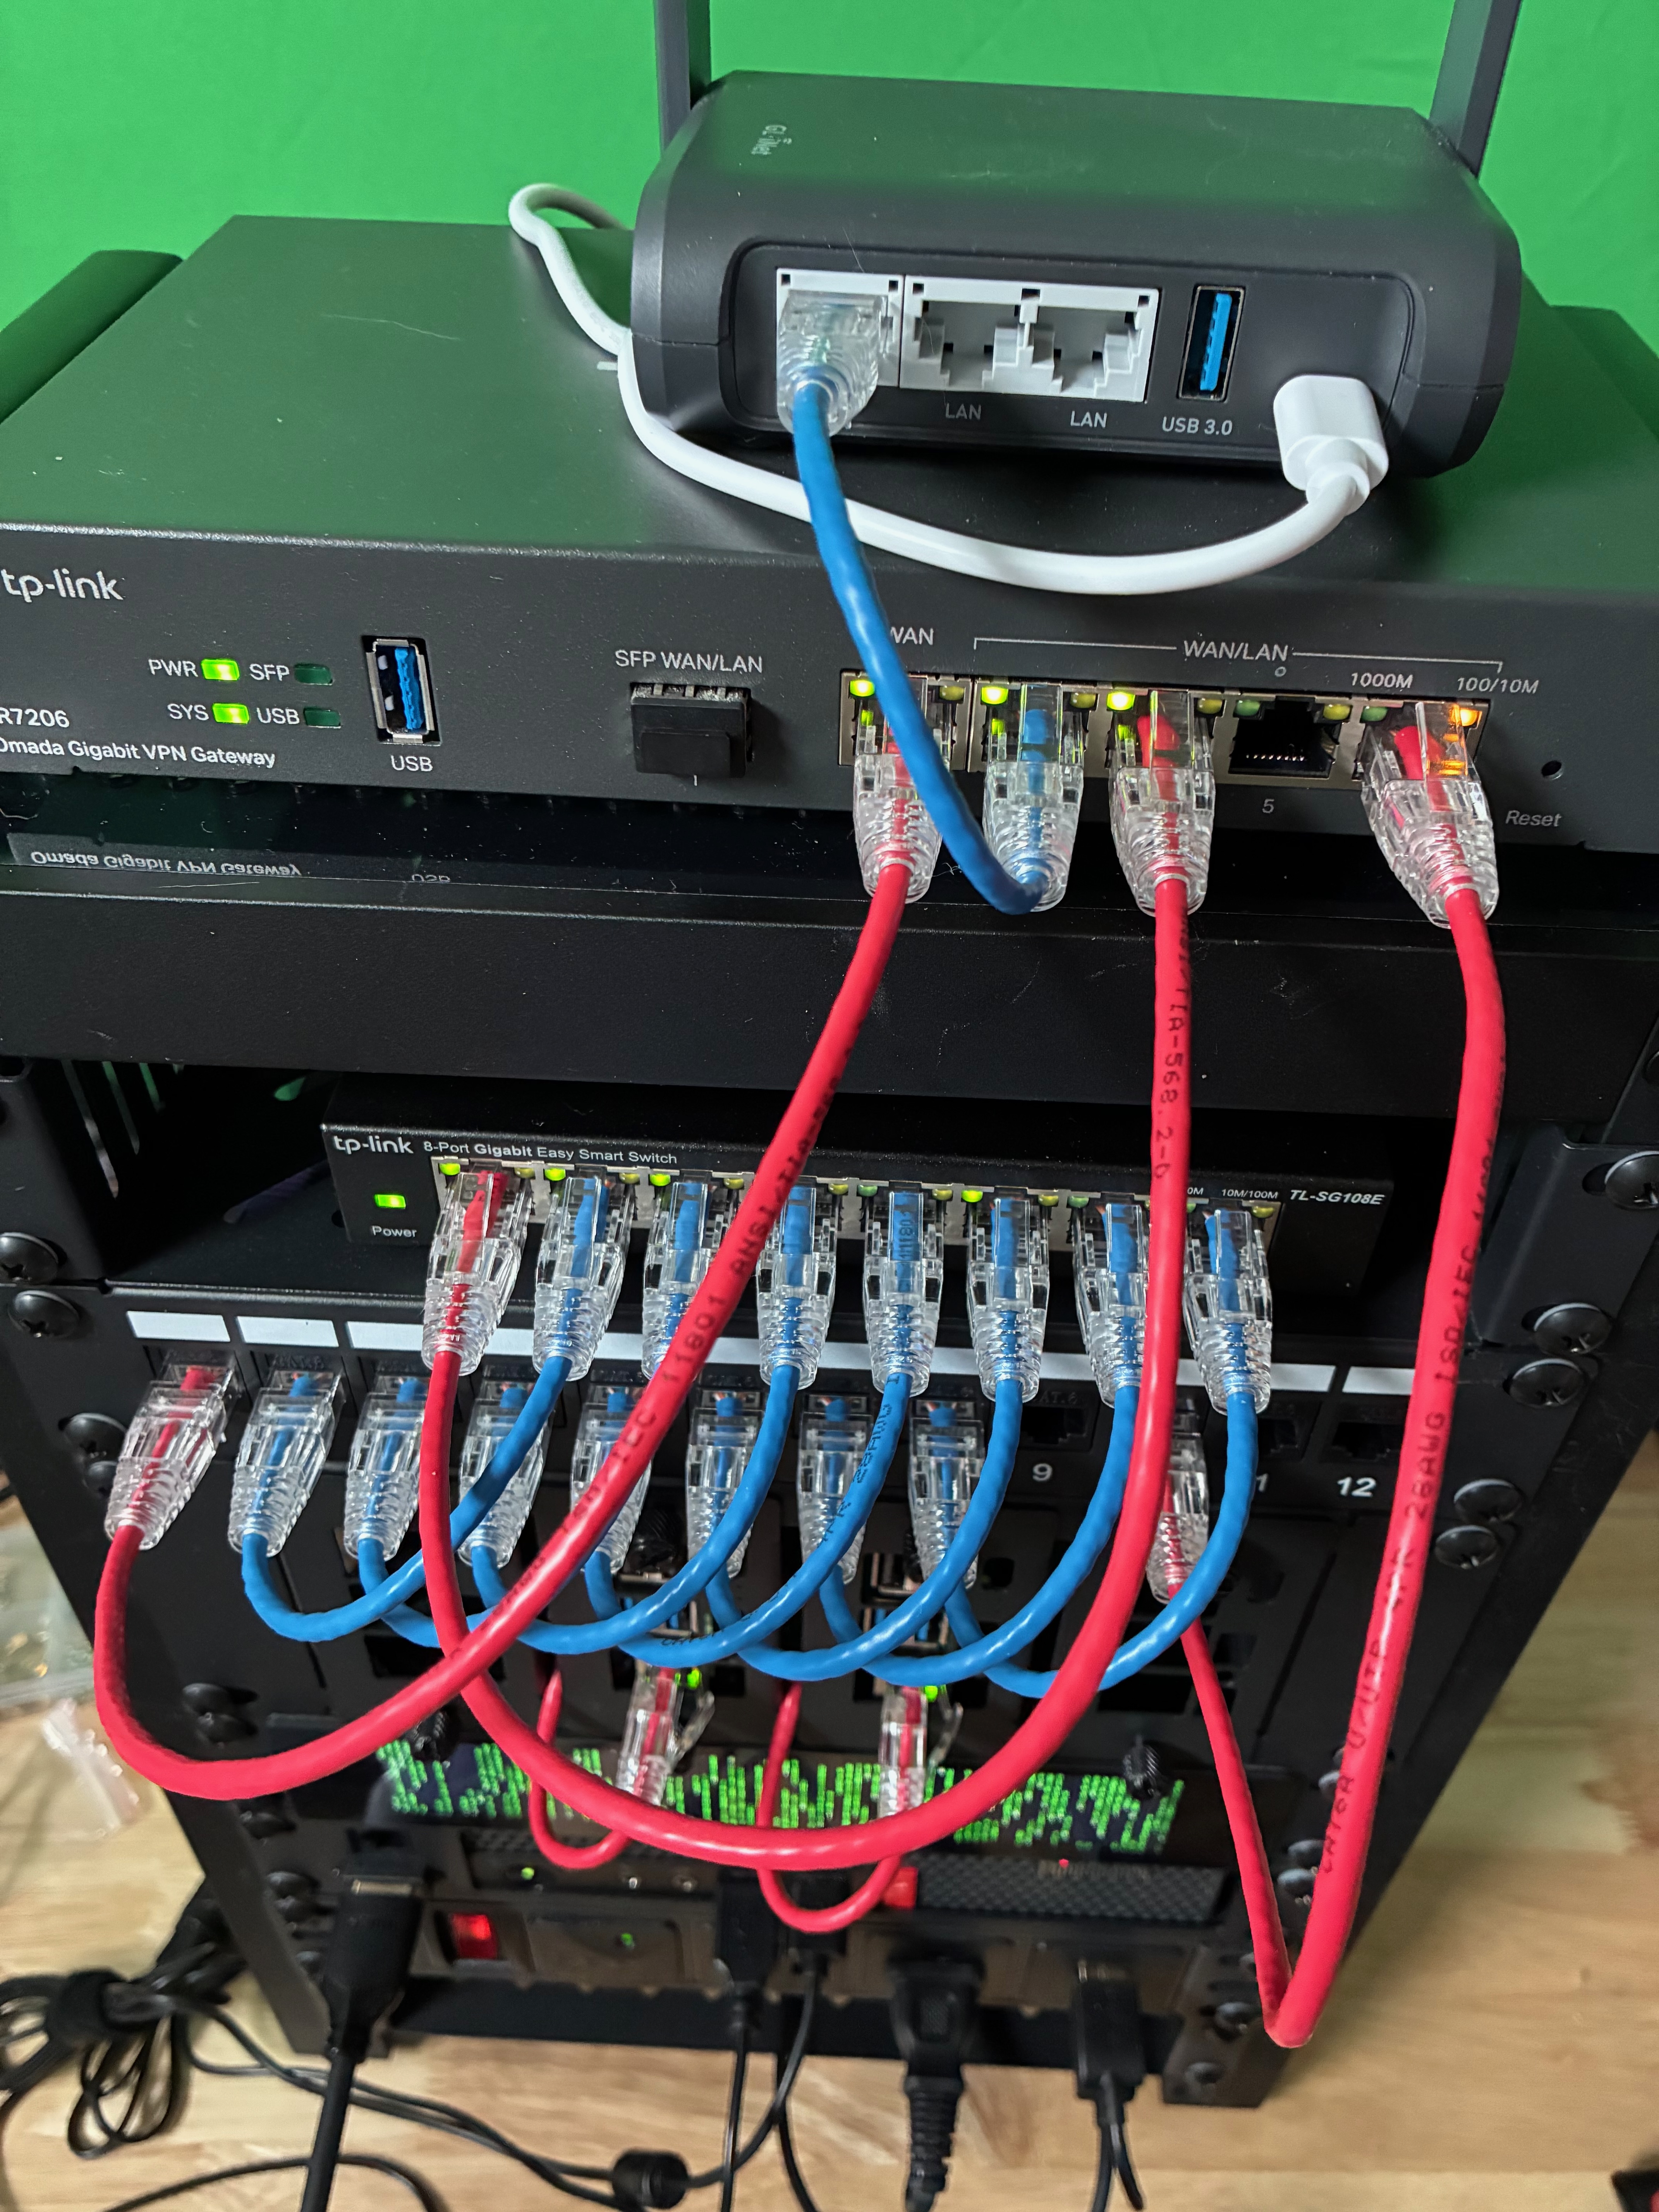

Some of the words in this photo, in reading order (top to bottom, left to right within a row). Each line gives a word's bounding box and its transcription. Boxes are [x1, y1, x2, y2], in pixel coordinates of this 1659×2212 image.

[945, 403, 981, 419] LAN
[1070, 410, 1107, 428] LAN
[1162, 416, 1199, 433] USB
[1204, 419, 1233, 435] 3.0
[1, 568, 124, 603] tp-link
[1184, 640, 1288, 661] WAN/LAN
[148, 659, 198, 677] PWR
[615, 649, 656, 667] SFP
[660, 651, 762, 674] WAN/LAN
[249, 663, 290, 681] SFP
[1352, 673, 1413, 691] 1000M
[1458, 677, 1539, 694] 100/10M
[167, 703, 209, 721] SYS
[256, 707, 300, 725] USB
[68, 740, 141, 761] Gigabit
[141, 744, 187, 761] VPN
[191, 746, 275, 768] Gateway
[391, 755, 433, 772] USB
[1262, 799, 1274, 814] 5
[1506, 810, 1562, 827] Reset
[333, 1135, 414, 1154] tp-link
[424, 1141, 470, 1154] 8-Port
[474, 1144, 533, 1157] Gigabit
[536, 1147, 574, 1162] Easy
[579, 1149, 624, 1161] Smart
[629, 1151, 677, 1164] Switch
[1222, 1189, 1278, 1199] 10M/100M
[1290, 1190, 1385, 1205] TL-SG108E
[372, 1225, 417, 1237] Power
[1038, 1391, 1079, 1407] AT.6
[1033, 1463, 1052, 1481] 9
[1256, 1474, 1267, 1491] 1
[1338, 1477, 1376, 1496] 12
